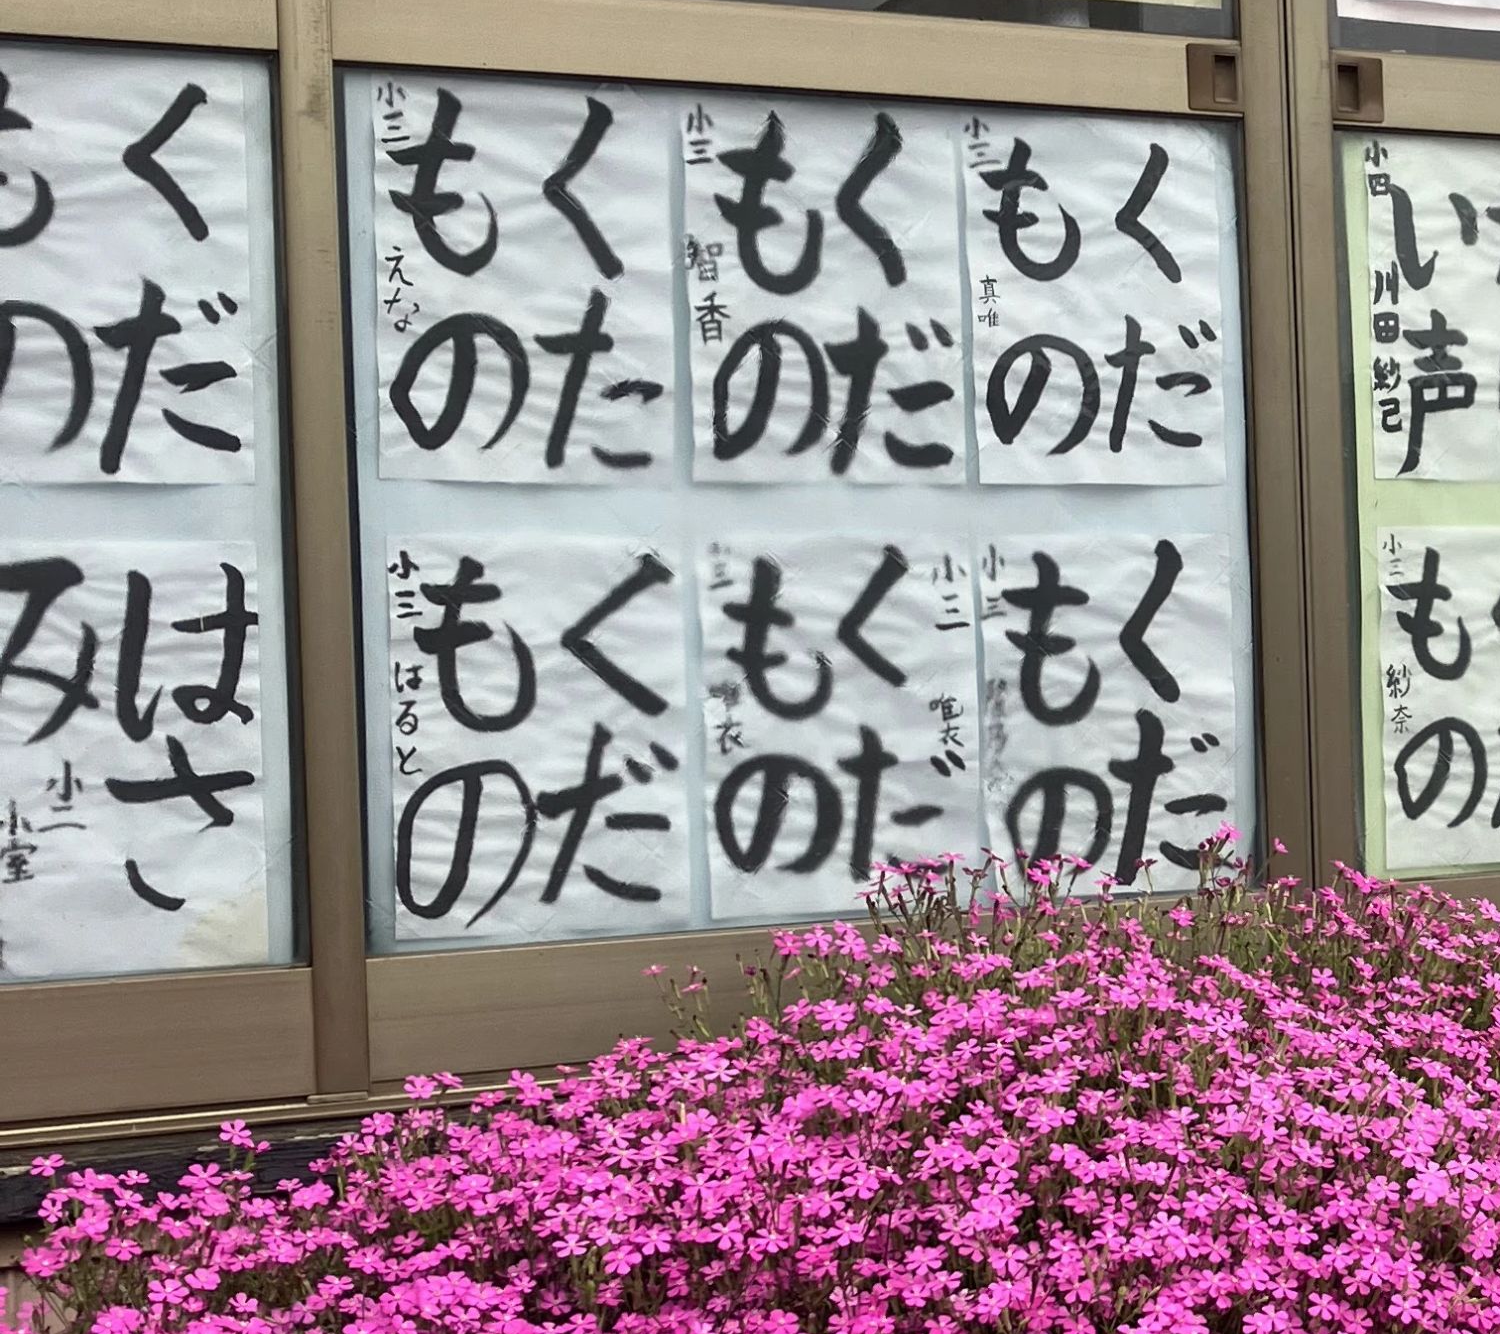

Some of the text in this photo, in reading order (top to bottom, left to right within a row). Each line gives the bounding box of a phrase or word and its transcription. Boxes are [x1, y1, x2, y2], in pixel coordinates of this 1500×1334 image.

[377, 82, 411, 144] 小三
[387, 88, 530, 450] もの
[686, 103, 714, 166] 小三
[963, 116, 1000, 170] 小三
[94, 82, 241, 474] くだ
[712, 109, 830, 462] もの
[823, 111, 956, 476] くだ
[978, 137, 1100, 457] もの
[1104, 142, 1218, 454] くだ
[1389, 183, 1478, 476] い声
[388, 551, 424, 776] 小三 はると
[714, 555, 843, 874] もの
[933, 554, 971, 631] 小三
[1002, 550, 1114, 874] もの
[1108, 538, 1228, 885] くだ
[1383, 534, 1404, 577] 小三
[1386, 546, 1487, 828] もの
[104, 562, 258, 911] はさ
[396, 556, 536, 929] もの
[535, 552, 679, 904] くだ
